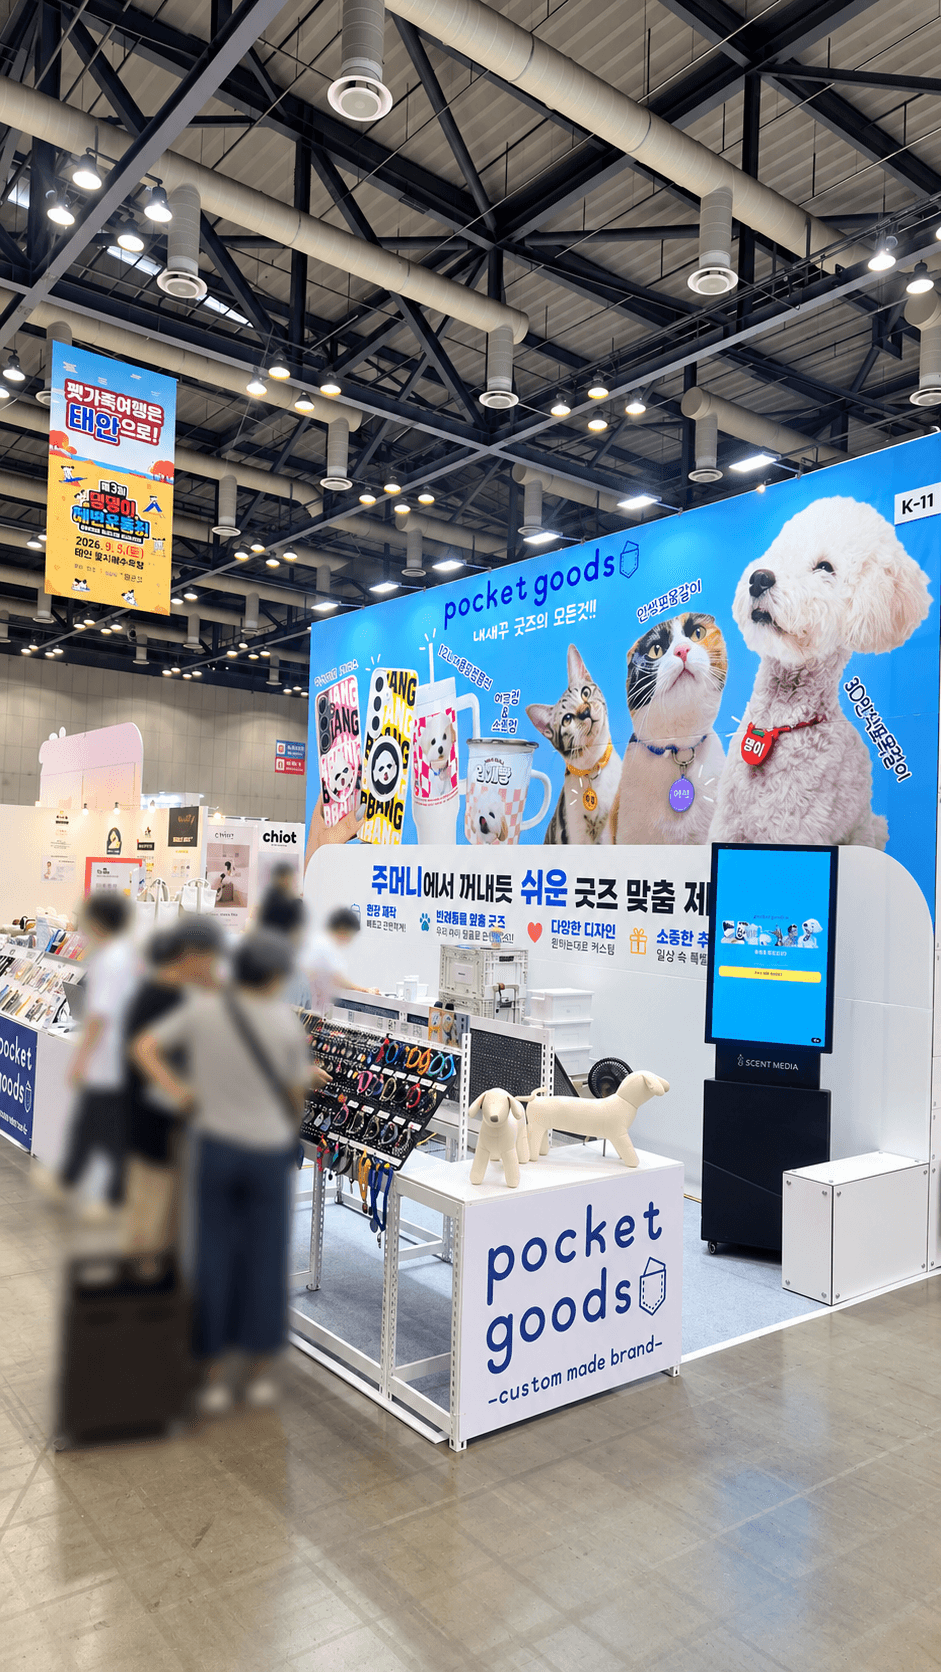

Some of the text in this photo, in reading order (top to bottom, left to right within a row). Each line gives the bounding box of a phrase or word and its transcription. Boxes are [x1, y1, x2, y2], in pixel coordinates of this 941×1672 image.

[67, 382, 162, 424] 펫가족여행은
[70, 403, 158, 443] 태안으로!
[902, 493, 934, 515] K-11
[76, 536, 103, 550] 2026.
[444, 548, 615, 630] pocket goods
[473, 620, 509, 641] 내새꾸
[513, 612, 548, 637] 굿즈의
[501, 706, 508, 718] &
[262, 830, 297, 844] chiot
[371, 865, 454, 900] 주머니에서
[459, 873, 513, 904] 꺼내듯
[520, 868, 568, 907] 쉬운
[574, 877, 618, 910] 굿즈
[626, 879, 676, 914] 맞춤
[551, 919, 616, 939] 다양한 디자인
[656, 928, 694, 947] 소중한
[656, 948, 675, 963] 일상
[745, 1059, 799, 1071] SCENT MEDIA
[0, 1072, 24, 1104] oods
[486, 1201, 662, 1306] pocket
[486, 1266, 632, 1375] goods
[567, 1353, 606, 1382] made
